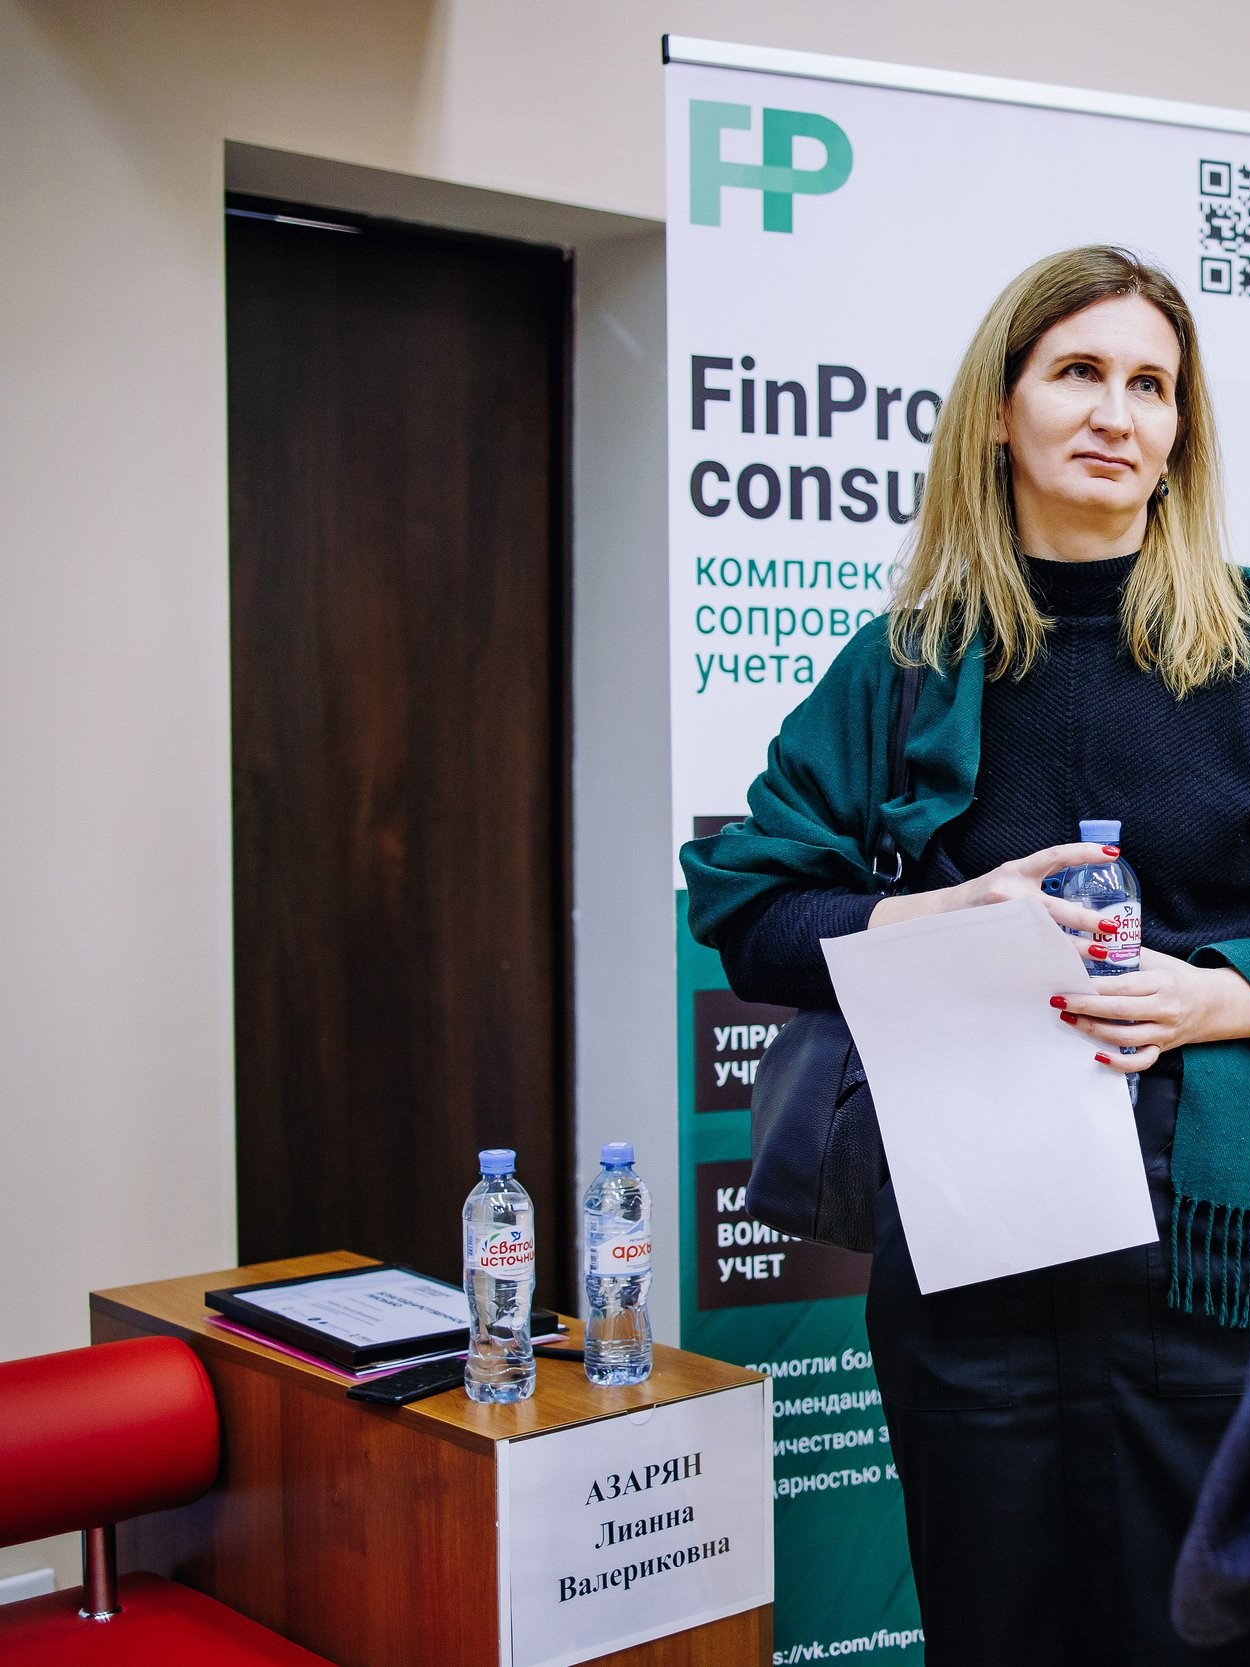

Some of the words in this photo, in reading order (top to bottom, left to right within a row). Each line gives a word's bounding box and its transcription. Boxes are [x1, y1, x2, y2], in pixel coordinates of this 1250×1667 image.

[695, 653, 814, 694] учета
[713, 1023, 785, 1052] УПРА
[717, 1252, 786, 1283] УЧЕТ
[584, 1451, 703, 1507] АЗАРЯН
[773, 1465, 881, 1500] арностью
[594, 1504, 695, 1550] Лианна
[557, 1535, 731, 1603] Валериковна
